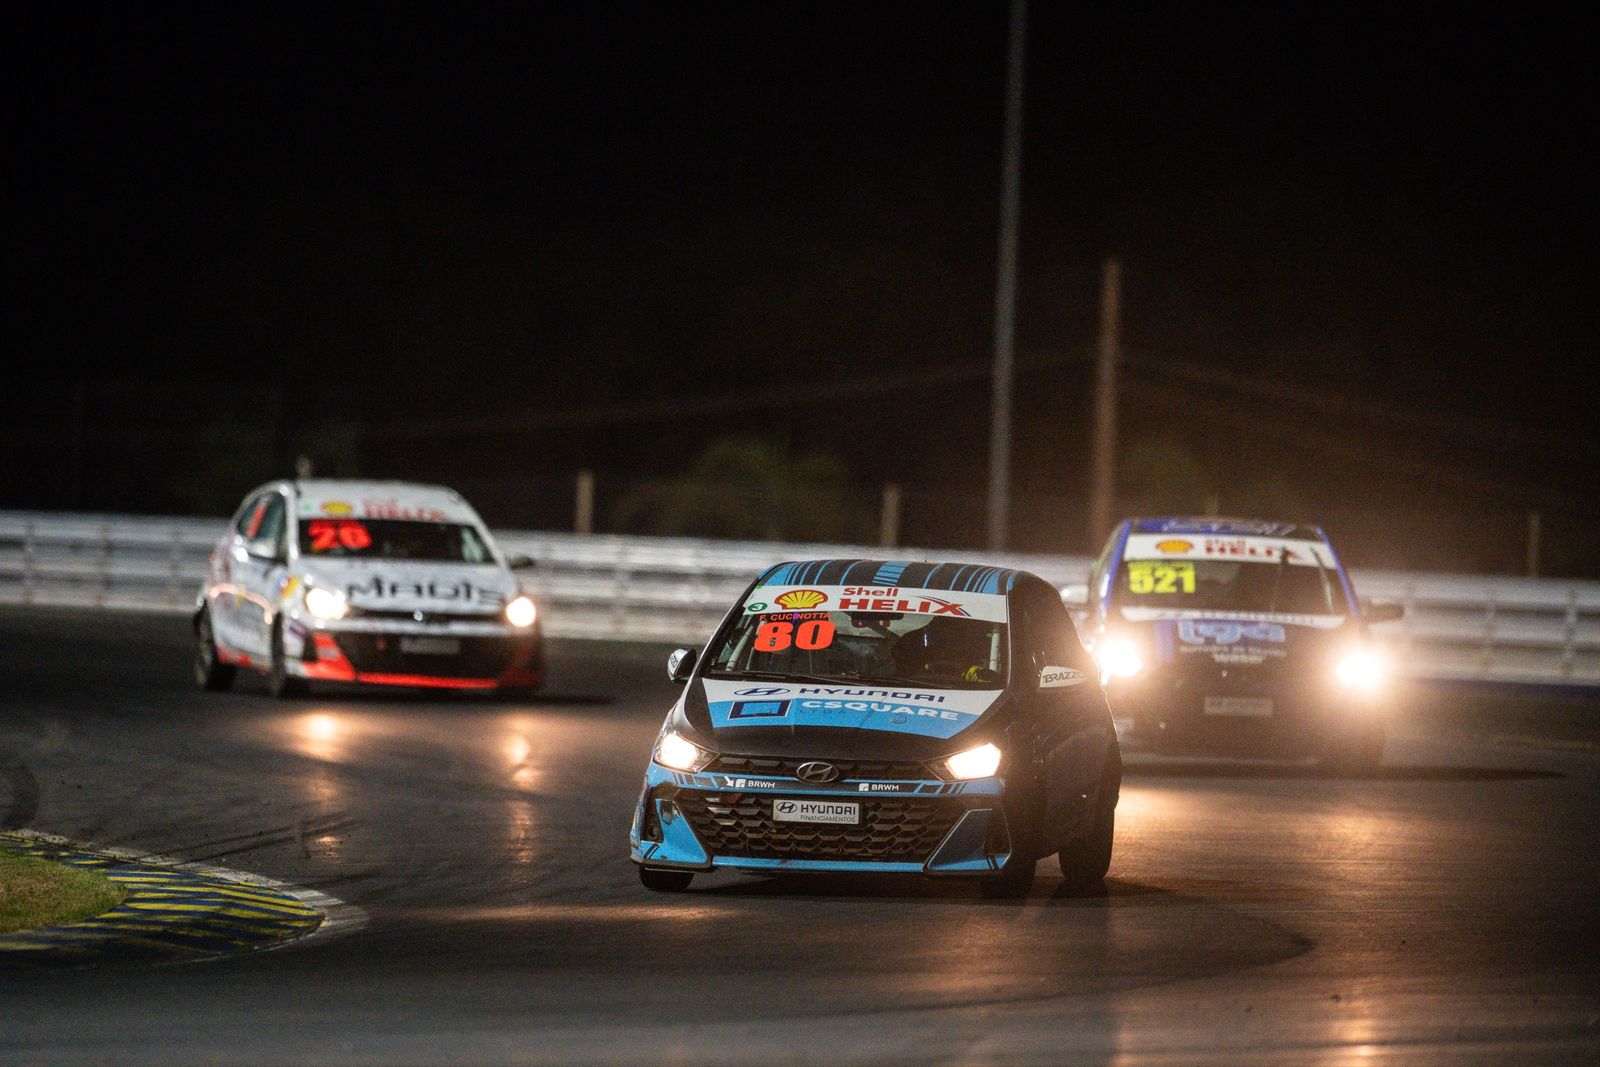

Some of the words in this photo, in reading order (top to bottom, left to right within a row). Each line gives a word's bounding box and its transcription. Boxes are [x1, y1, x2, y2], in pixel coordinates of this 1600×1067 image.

[1128, 567, 1196, 593] 521
[843, 587, 898, 597] Shell
[839, 595, 971, 617] HELIX
[754, 620, 835, 652] 80
[800, 687, 945, 703] HYUNDAI
[802, 701, 958, 721] CSQUARE
[748, 780, 776, 789] BRWM
[871, 783, 900, 791] BRWM
[800, 803, 856, 816] HYUNDAI
[800, 814, 856, 823] FINANCIAMENTOS
